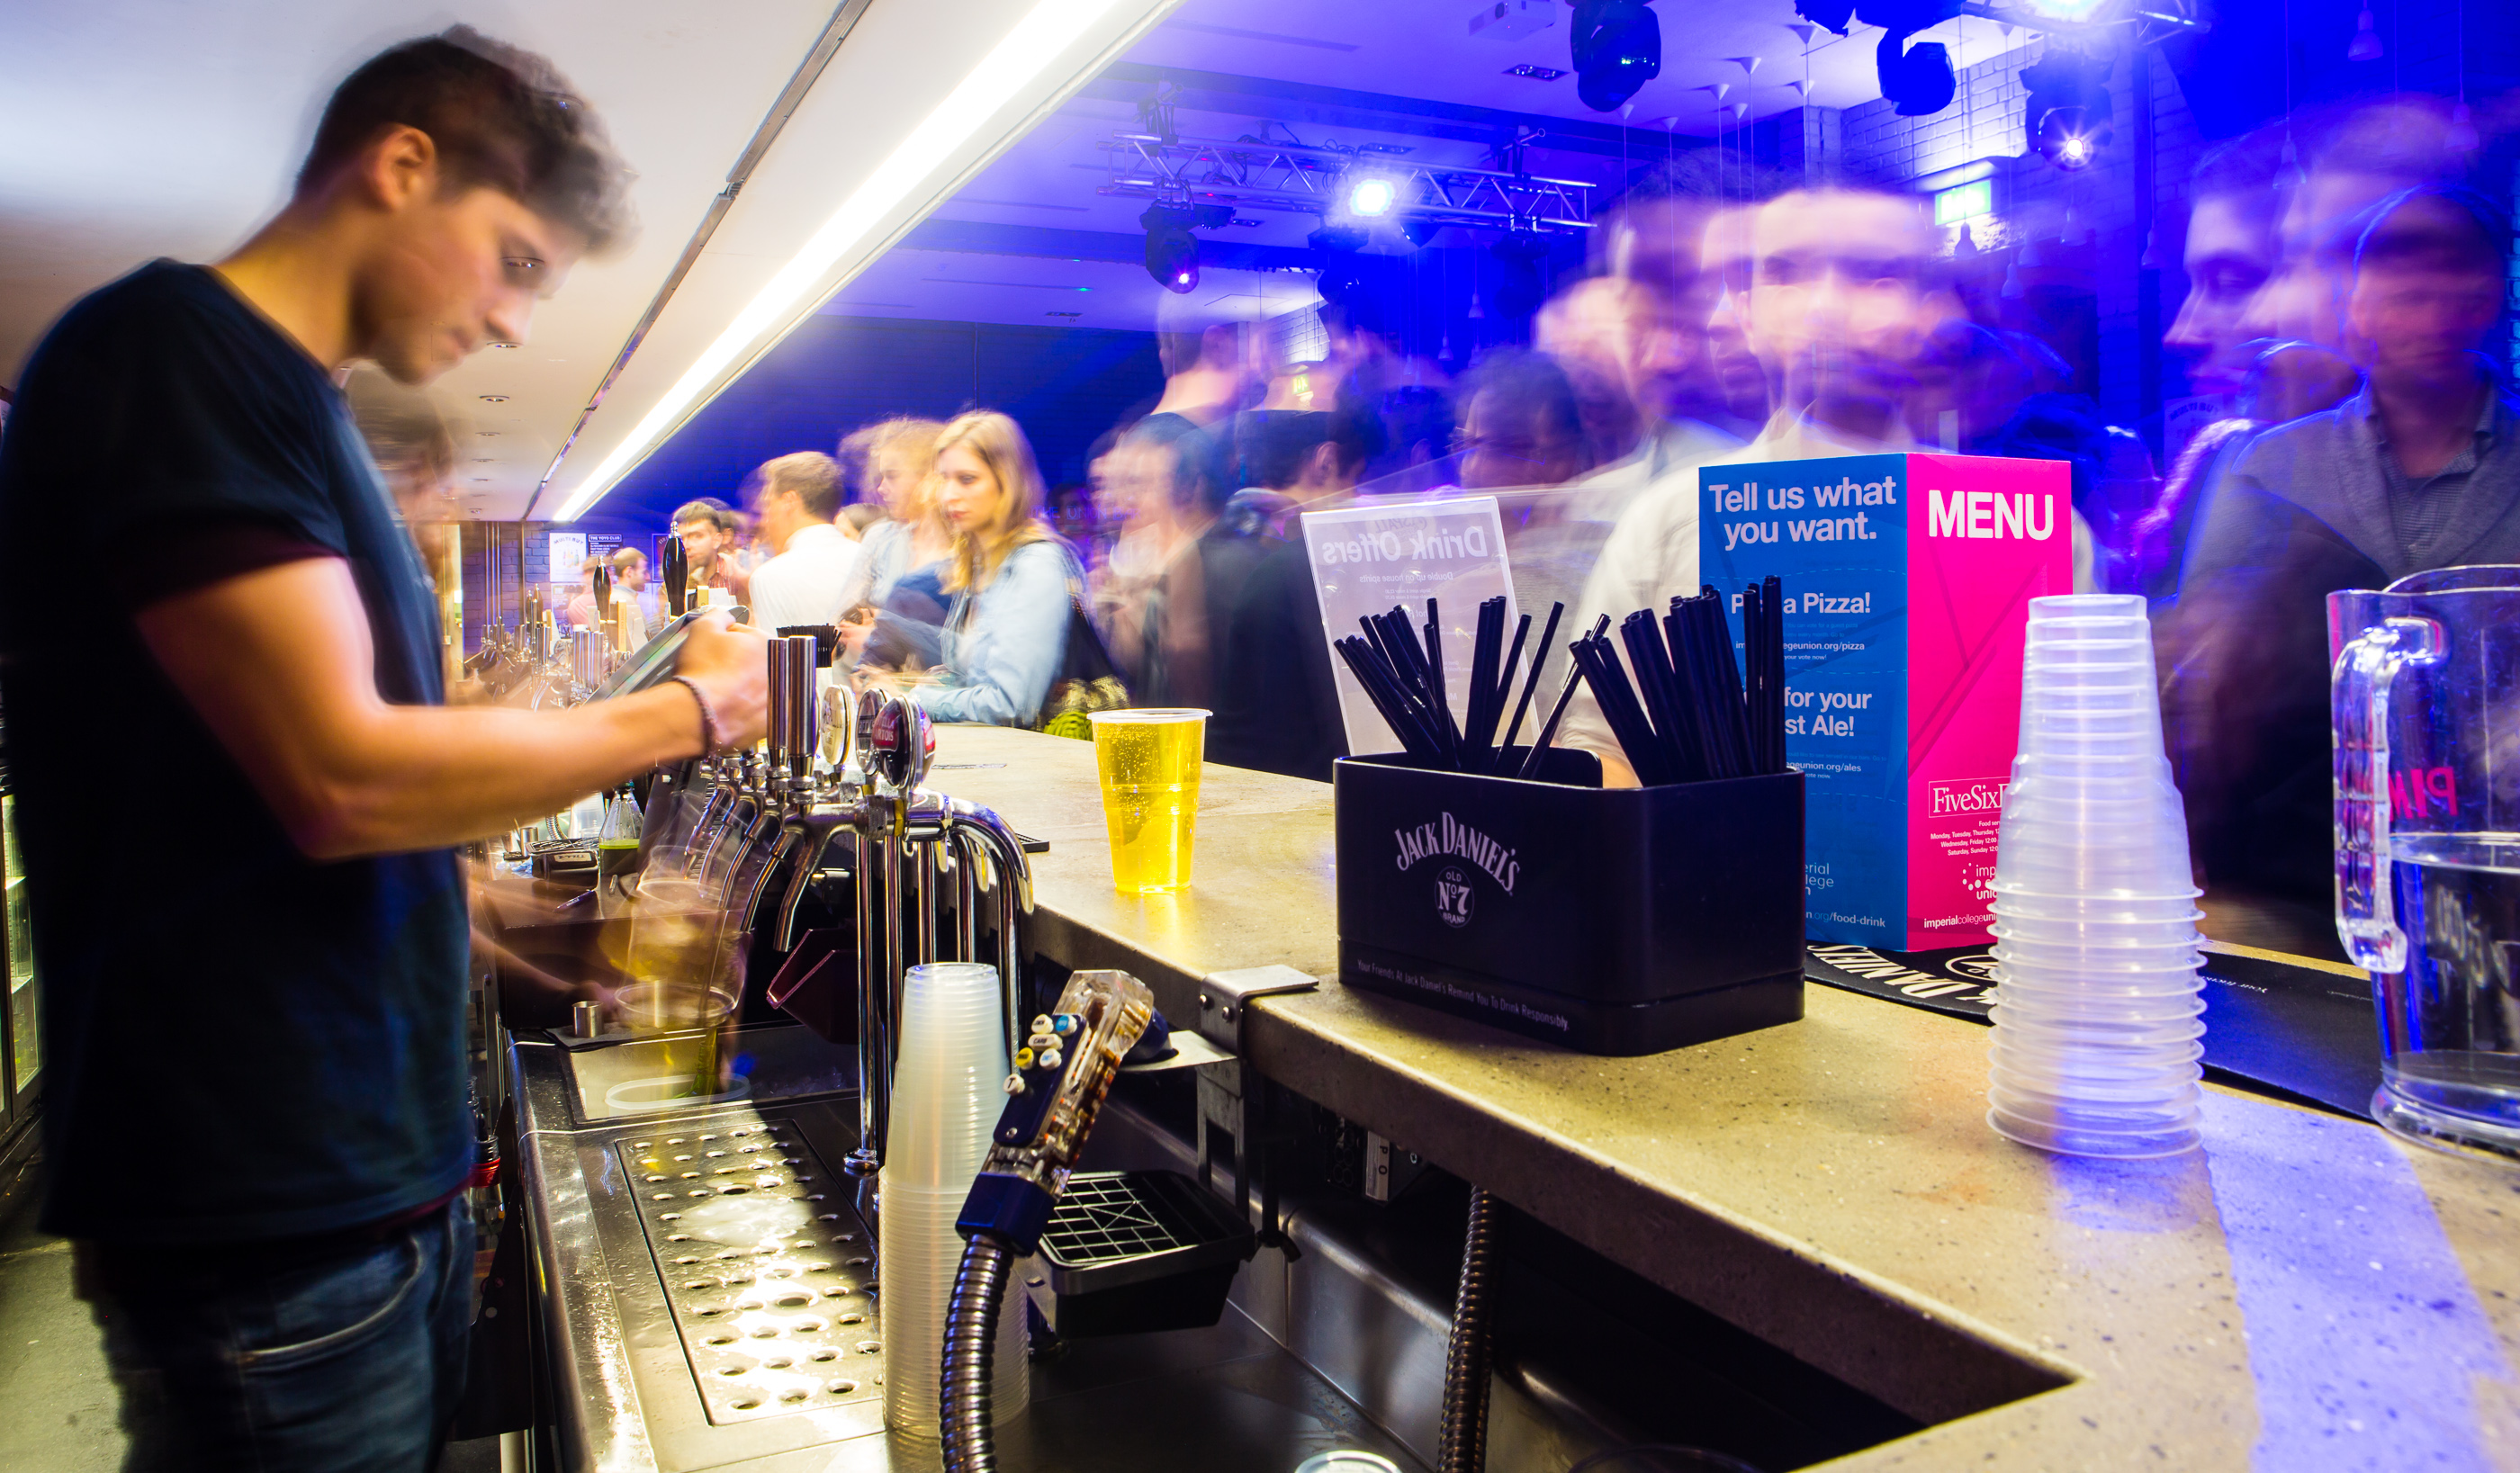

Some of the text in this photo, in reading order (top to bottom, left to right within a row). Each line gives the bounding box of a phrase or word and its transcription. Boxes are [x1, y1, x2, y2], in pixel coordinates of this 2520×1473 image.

[1708, 476, 1897, 513] Tell us what
[1928, 489, 2055, 541] MENU
[1724, 511, 1877, 552] you want.
[1783, 597, 1796, 614] a
[1804, 592, 1871, 614] Pizza!
[1784, 687, 1872, 713] for your
[1811, 714, 1855, 737] Ale!
[1930, 832, 1951, 840] Monday,
[1952, 831, 1972, 839] Tuesday,
[1973, 829, 1994, 837] Thursday
[1940, 840, 1969, 848] Wednesday,
[1394, 812, 1520, 892] JACK DANIEL'S
[1947, 849, 1969, 857] Saturday,
[1970, 847, 1988, 855] Sunday
[1445, 870, 1462, 883] OLD
[1443, 912, 1465, 924] BRAND
[1806, 944, 1980, 999] DANIELS
[1357, 958, 1371, 973] Your
[1372, 963, 1395, 980] Friends
[1396, 970, 1403, 982] At
[1405, 972, 1418, 986] Jack
[1419, 975, 1446, 994] Daniel's
[1447, 983, 1474, 1002] Remind
[1476, 992, 1489, 1007] You
[1490, 994, 1498, 1009] To
[1500, 998, 1520, 1015] Drink
[1007, 1077, 1016, 1089] T
